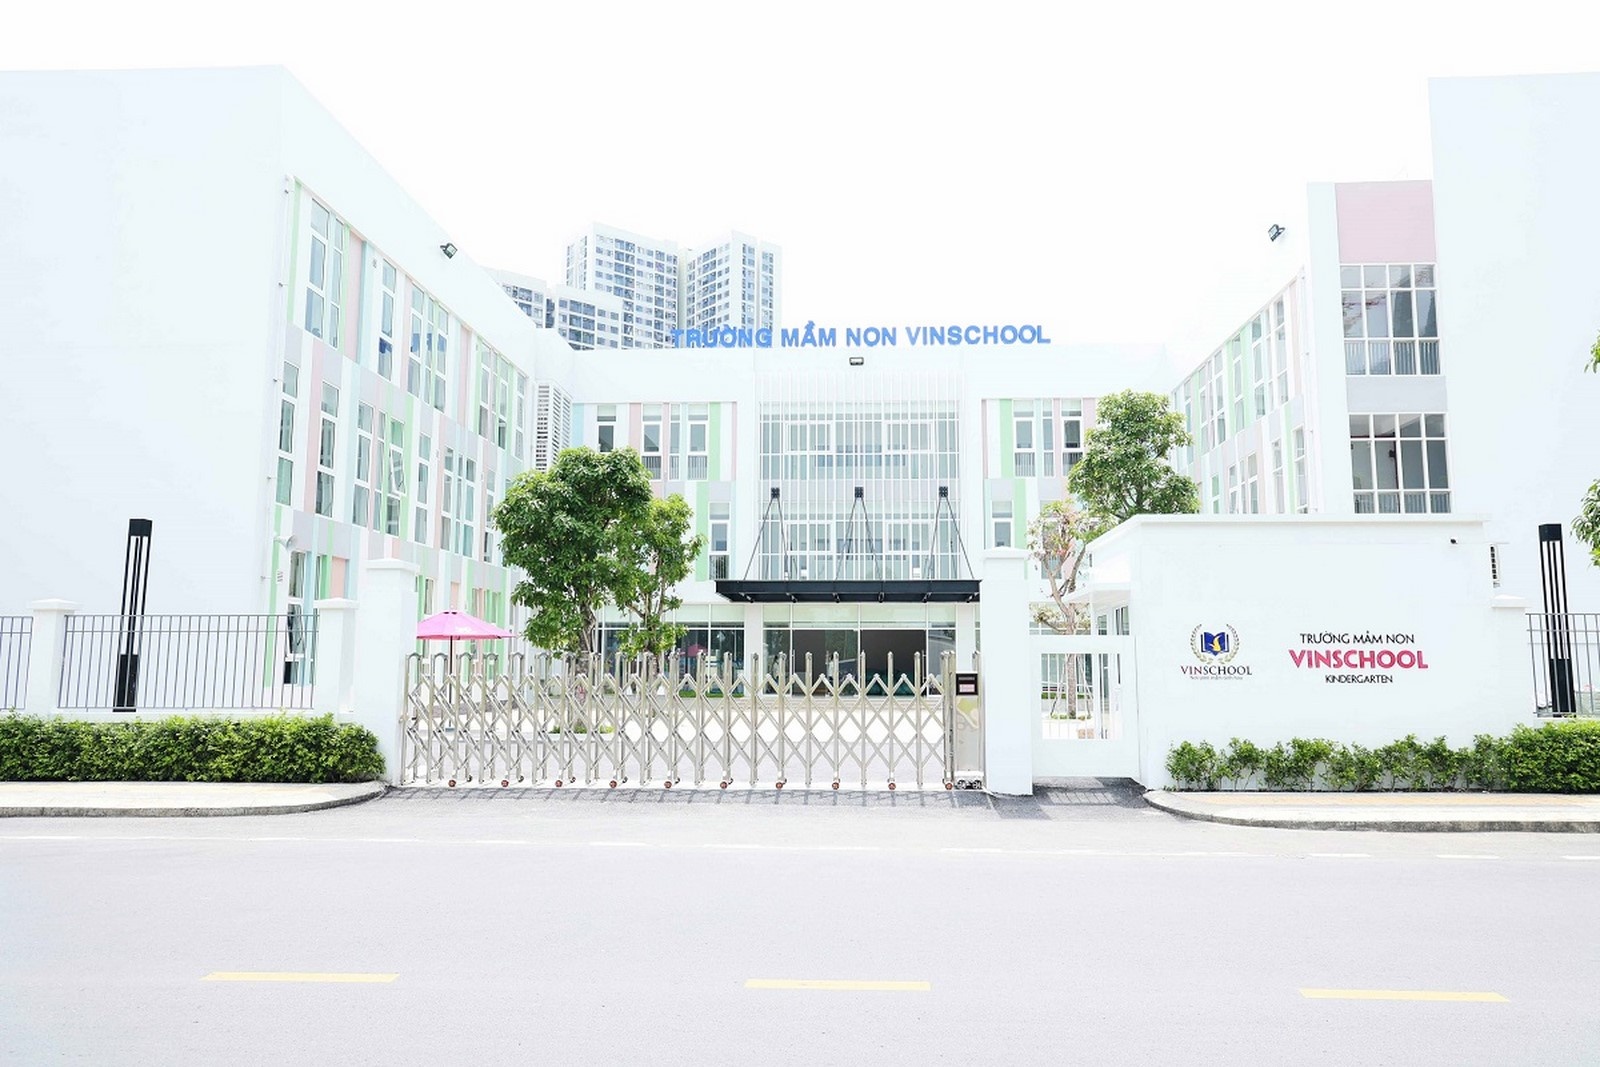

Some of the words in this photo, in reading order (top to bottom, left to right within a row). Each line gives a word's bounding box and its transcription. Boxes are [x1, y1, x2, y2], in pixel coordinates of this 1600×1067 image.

[672, 324, 772, 348] TRƯỜNG
[846, 327, 897, 346] NON
[905, 324, 1051, 346] VINSCHOOL
[1386, 633, 1415, 644] NON
[1288, 649, 1429, 669] VINSCHOOL
[1180, 665, 1253, 675] VINSCHOOL
[1325, 674, 1393, 684] KINDERGARTEN
